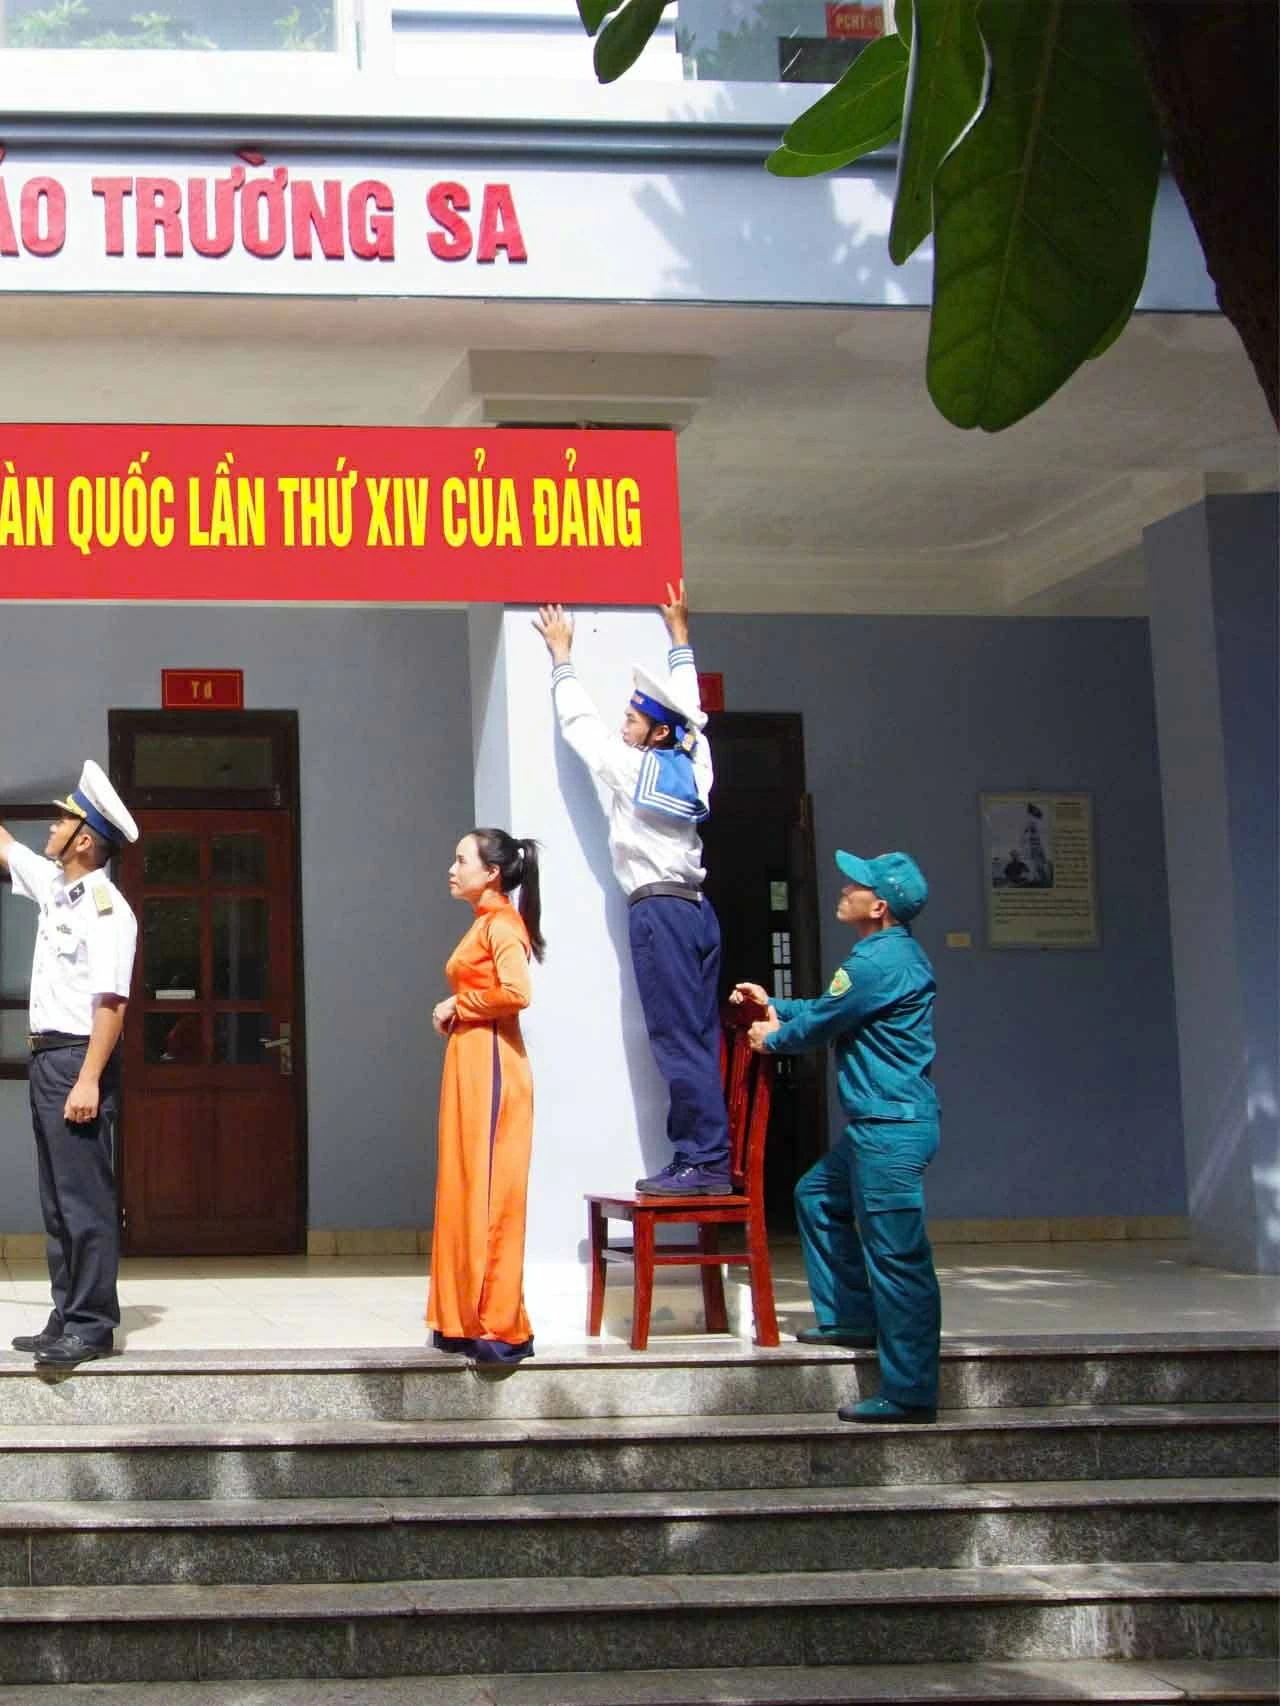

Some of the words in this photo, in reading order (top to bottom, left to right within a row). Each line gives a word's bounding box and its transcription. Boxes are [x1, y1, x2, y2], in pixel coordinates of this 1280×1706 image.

[91, 145, 396, 261] TRƯỜNG
[425, 179, 528, 263] SA
[68, 451, 175, 555] QUỐC
[188, 452, 266, 547] LẦN
[277, 456, 358, 548] THỨ
[365, 477, 429, 547] XIV
[442, 447, 523, 548] CỦA
[532, 447, 642, 548] ĐẢNG
